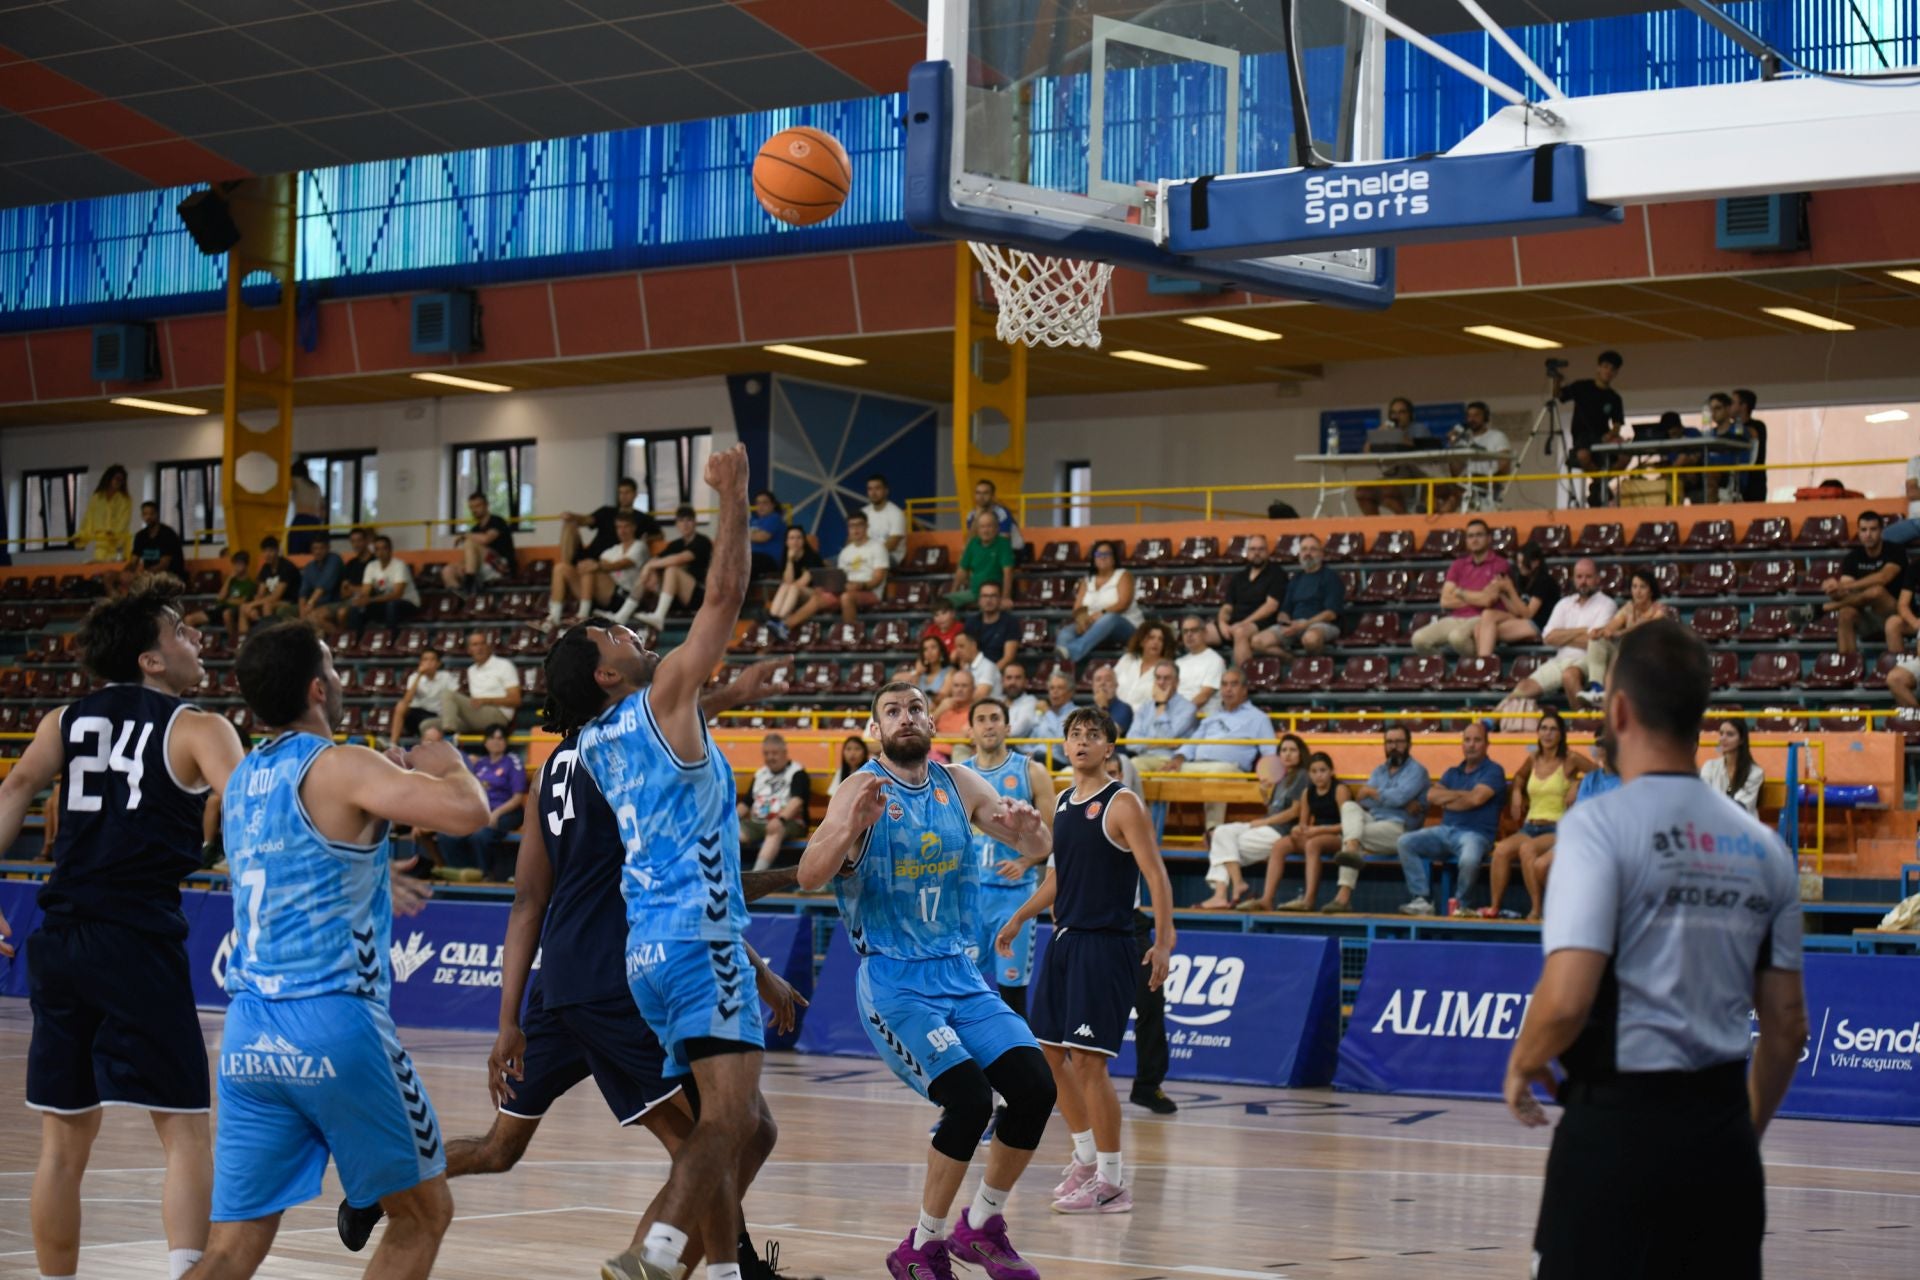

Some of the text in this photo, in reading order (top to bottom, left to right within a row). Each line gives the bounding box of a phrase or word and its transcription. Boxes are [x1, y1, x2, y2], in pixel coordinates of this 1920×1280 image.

[1305, 168, 1430, 201] Schelde
[1305, 193, 1430, 229] Sports
[68, 716, 154, 812] 24
[982, 842, 996, 867] 11
[1653, 822, 1767, 860] atiendo
[241, 868, 266, 962] 7
[919, 886, 941, 923] 17
[440, 941, 488, 967] CAJA
[432, 967, 503, 987] DE ZAMO
[1163, 953, 1245, 1007] aza
[1171, 1029, 1187, 1045] de
[1188, 1031, 1231, 1047] Zamora
[1833, 1017, 1920, 1054] Send
[220, 1052, 337, 1079] LEBANZA
[1830, 1052, 1913, 1072] Vivir seguros.
